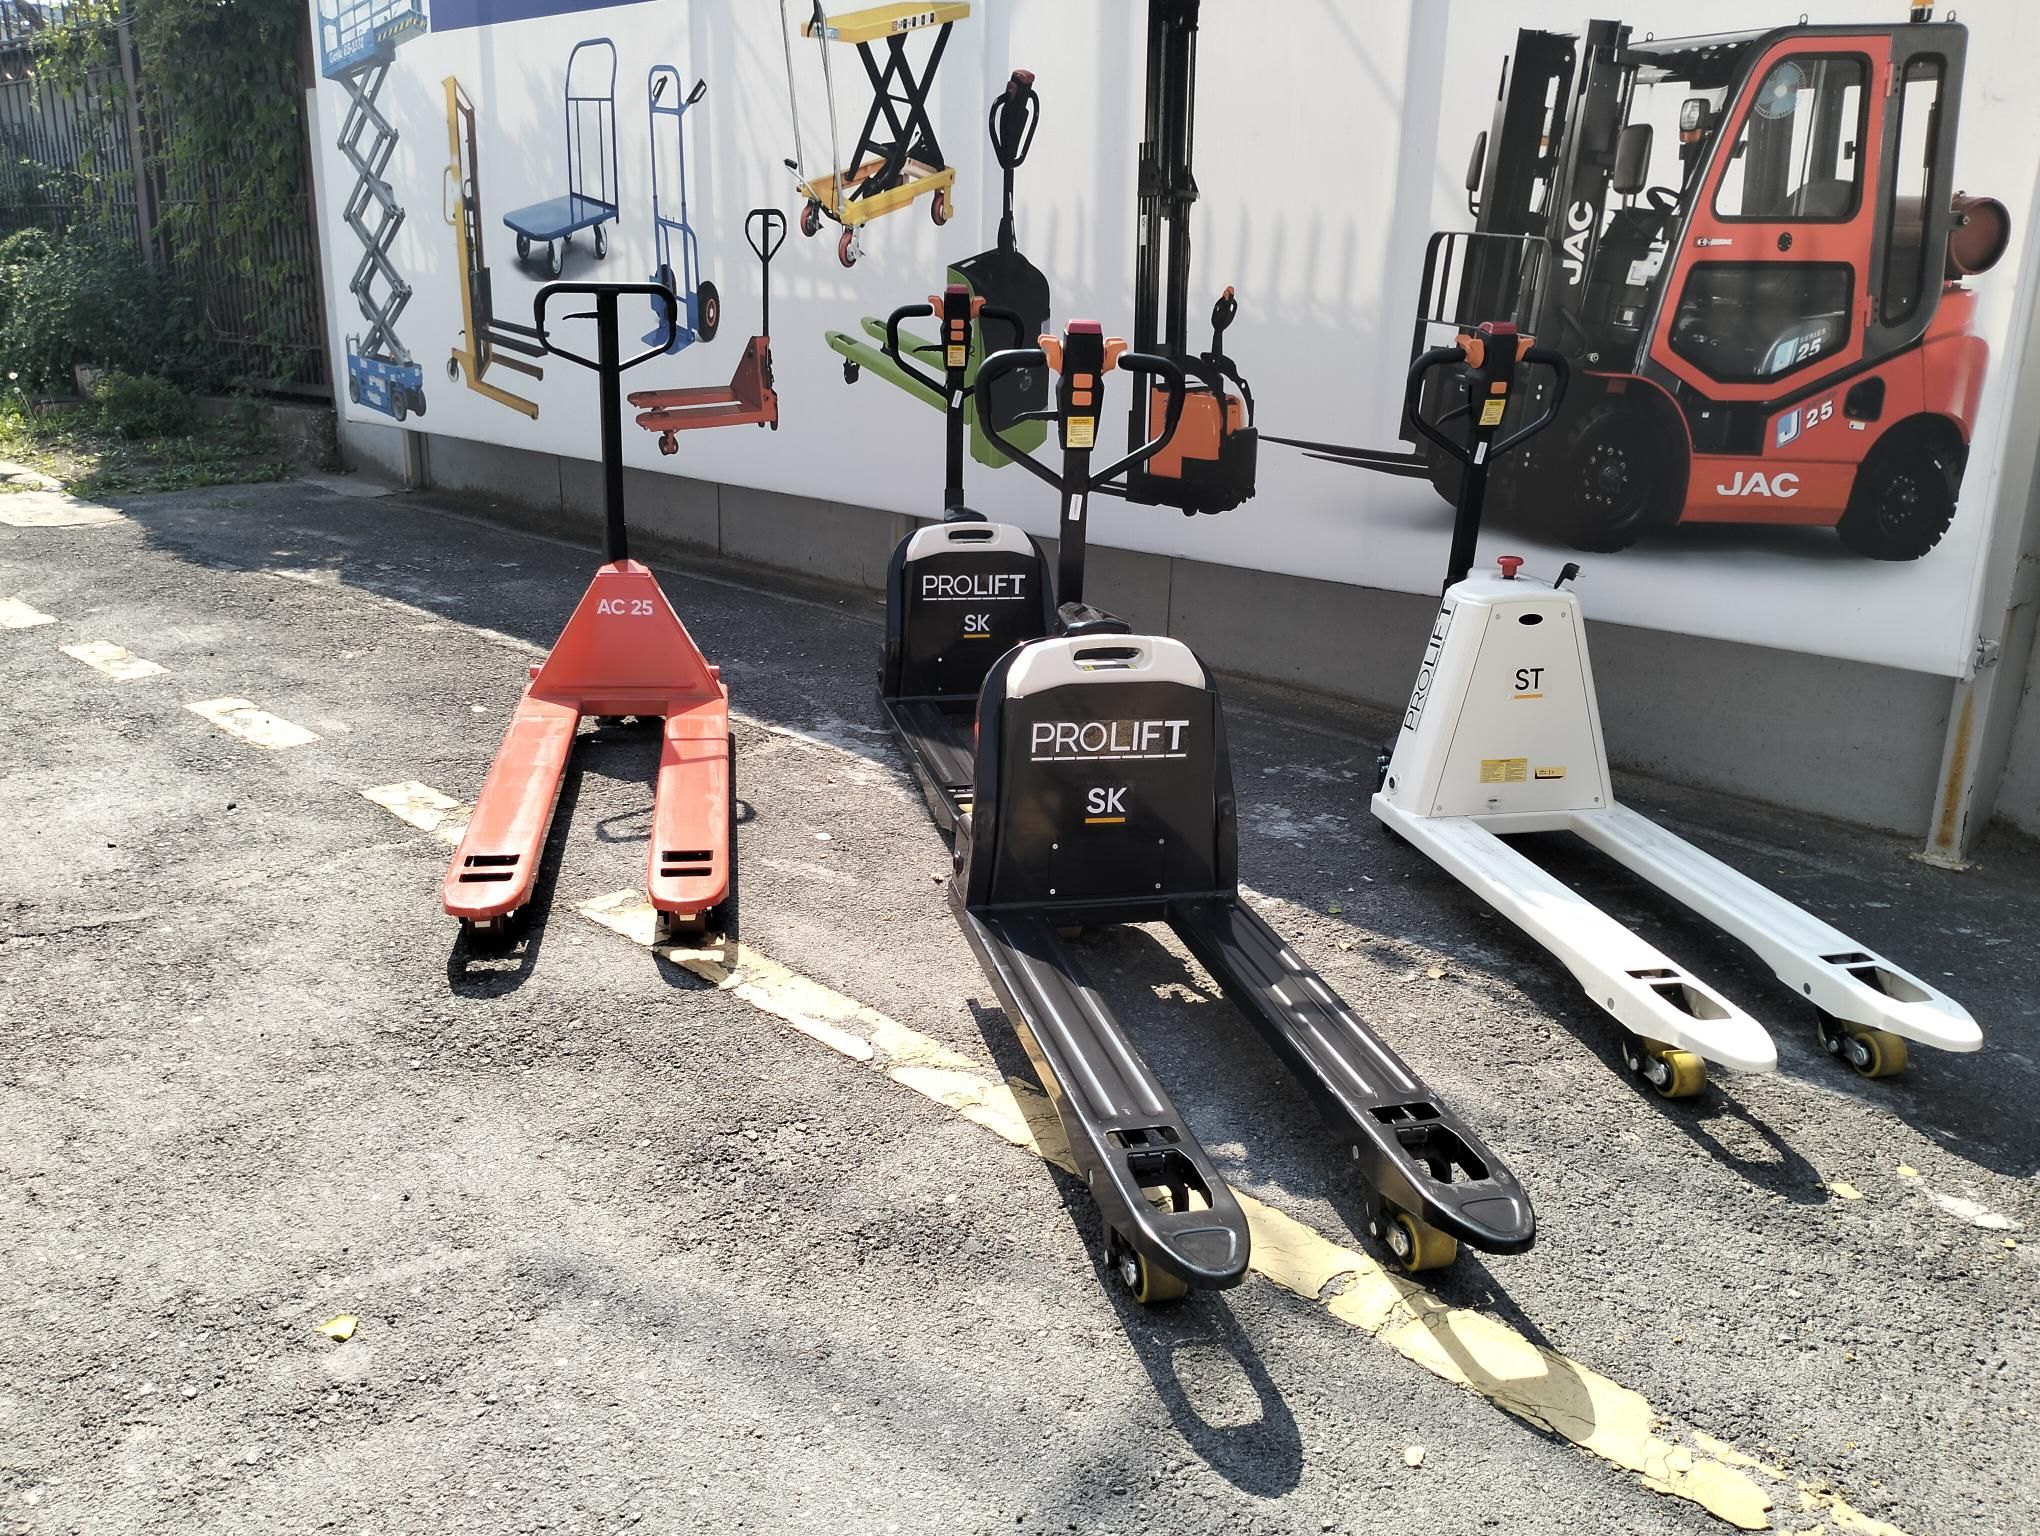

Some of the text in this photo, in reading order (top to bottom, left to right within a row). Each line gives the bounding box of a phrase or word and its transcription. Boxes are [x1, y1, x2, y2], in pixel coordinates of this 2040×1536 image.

[1562, 201, 1593, 285] JAC
[1800, 327, 1826, 343] SERIES
[1795, 338, 1822, 363] 25
[1806, 401, 1833, 429] 25
[1716, 472, 1800, 498] JAC
[922, 574, 1026, 596] PROLIFT
[597, 598, 653, 616] AC 25
[963, 614, 991, 632] SK
[1403, 600, 1452, 731] PROLIFT
[1514, 667, 1545, 690] ST
[1031, 719, 1190, 754] PROLIFT
[1086, 787, 1128, 814] SK
